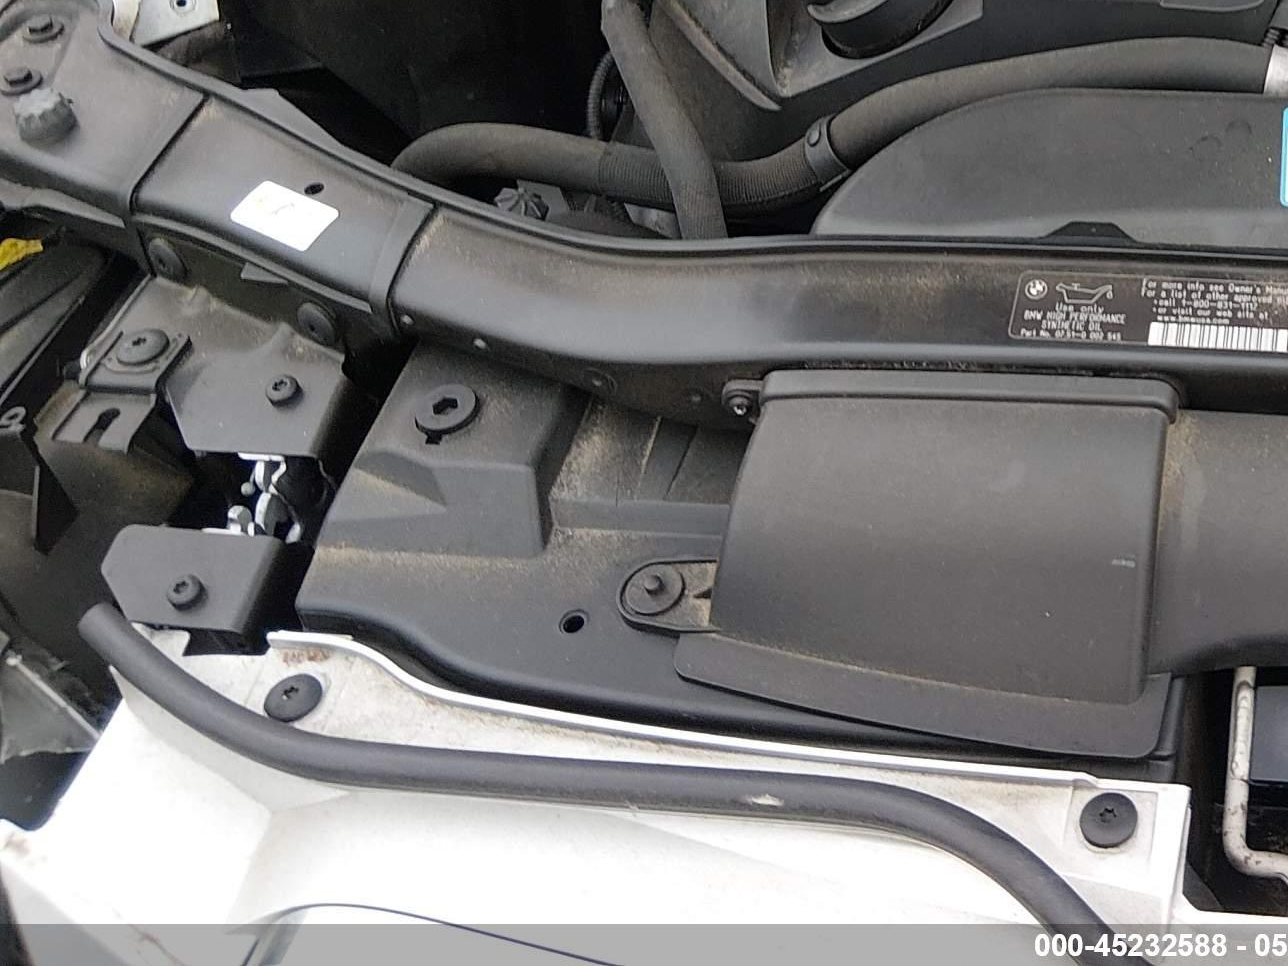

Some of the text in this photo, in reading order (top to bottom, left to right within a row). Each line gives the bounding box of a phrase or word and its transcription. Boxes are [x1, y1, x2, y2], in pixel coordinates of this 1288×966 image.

[1162, 281, 1182, 290] more
[1187, 281, 1205, 291] info
[1210, 284, 1224, 292] see
[1228, 282, 1261, 294] Owner's
[1160, 290, 1166, 298] a
[1171, 289, 1186, 299] list
[1191, 290, 1201, 299] of
[1206, 291, 1229, 301] other
[1233, 294, 1272, 305] approved
[1055, 301, 1104, 314] Use only
[1172, 306, 1192, 316] visit
[1216, 309, 1232, 318] web
[1236, 310, 1254, 319] site
[1259, 311, 1269, 320] at
[1024, 309, 1126, 324] BMW HIGH PERFORMANCE
[1041, 319, 1103, 331] SYNTHETIC OIL
